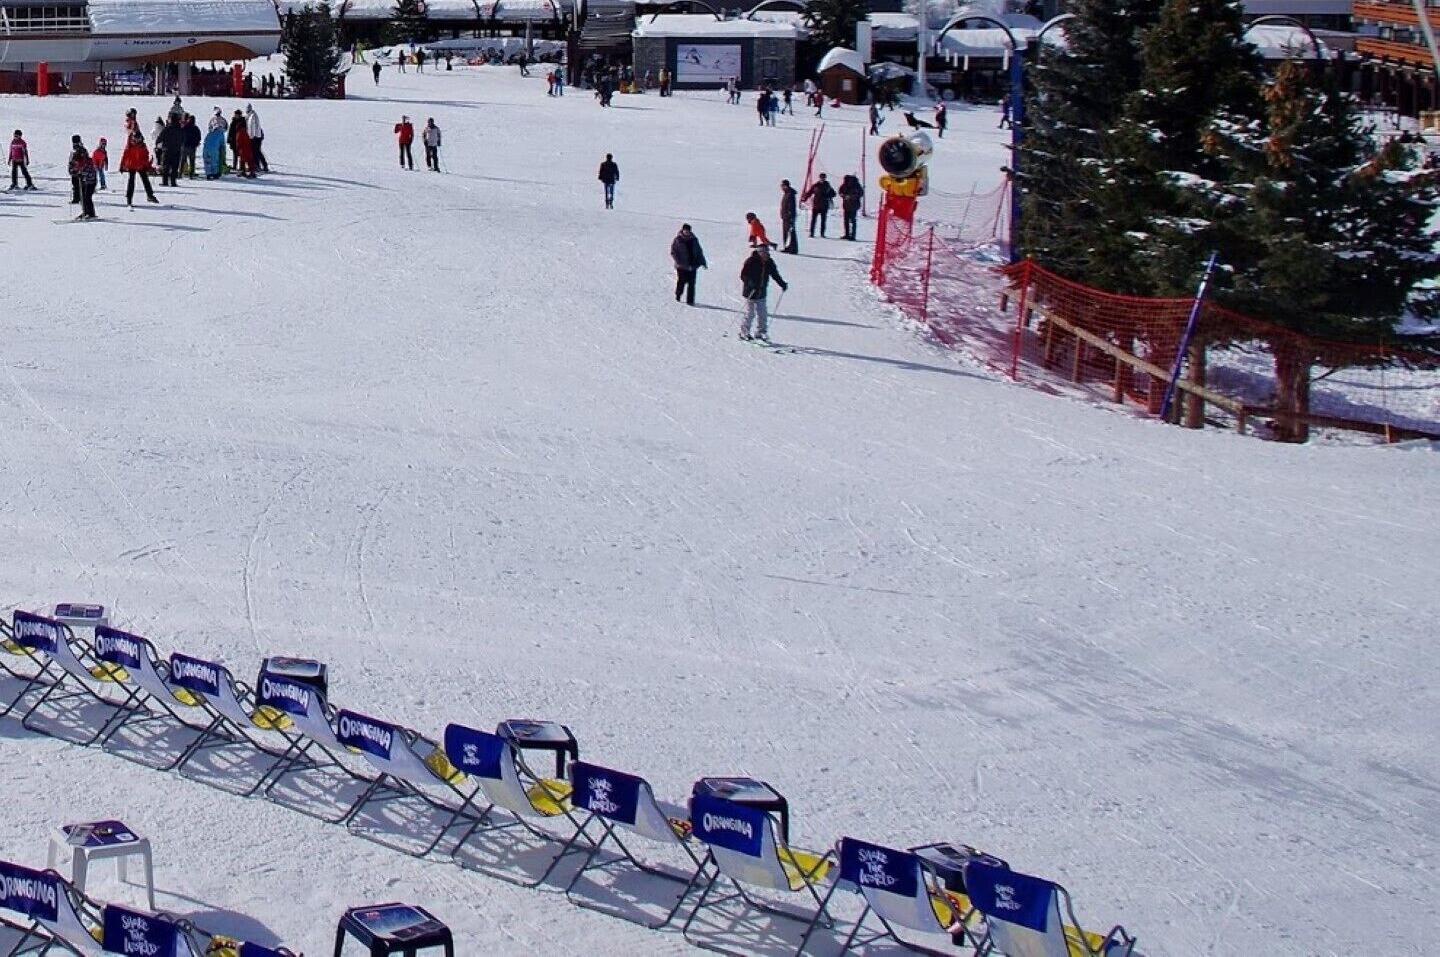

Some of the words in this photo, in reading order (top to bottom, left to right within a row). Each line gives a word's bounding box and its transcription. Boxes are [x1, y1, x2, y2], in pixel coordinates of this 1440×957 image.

[96, 634, 140, 660] ORANGINA
[173, 659, 217, 686] ORANGINA
[262, 678, 308, 708] ORANGINA
[340, 716, 390, 750] ORANGINA
[703, 812, 752, 839] ORANGINA
